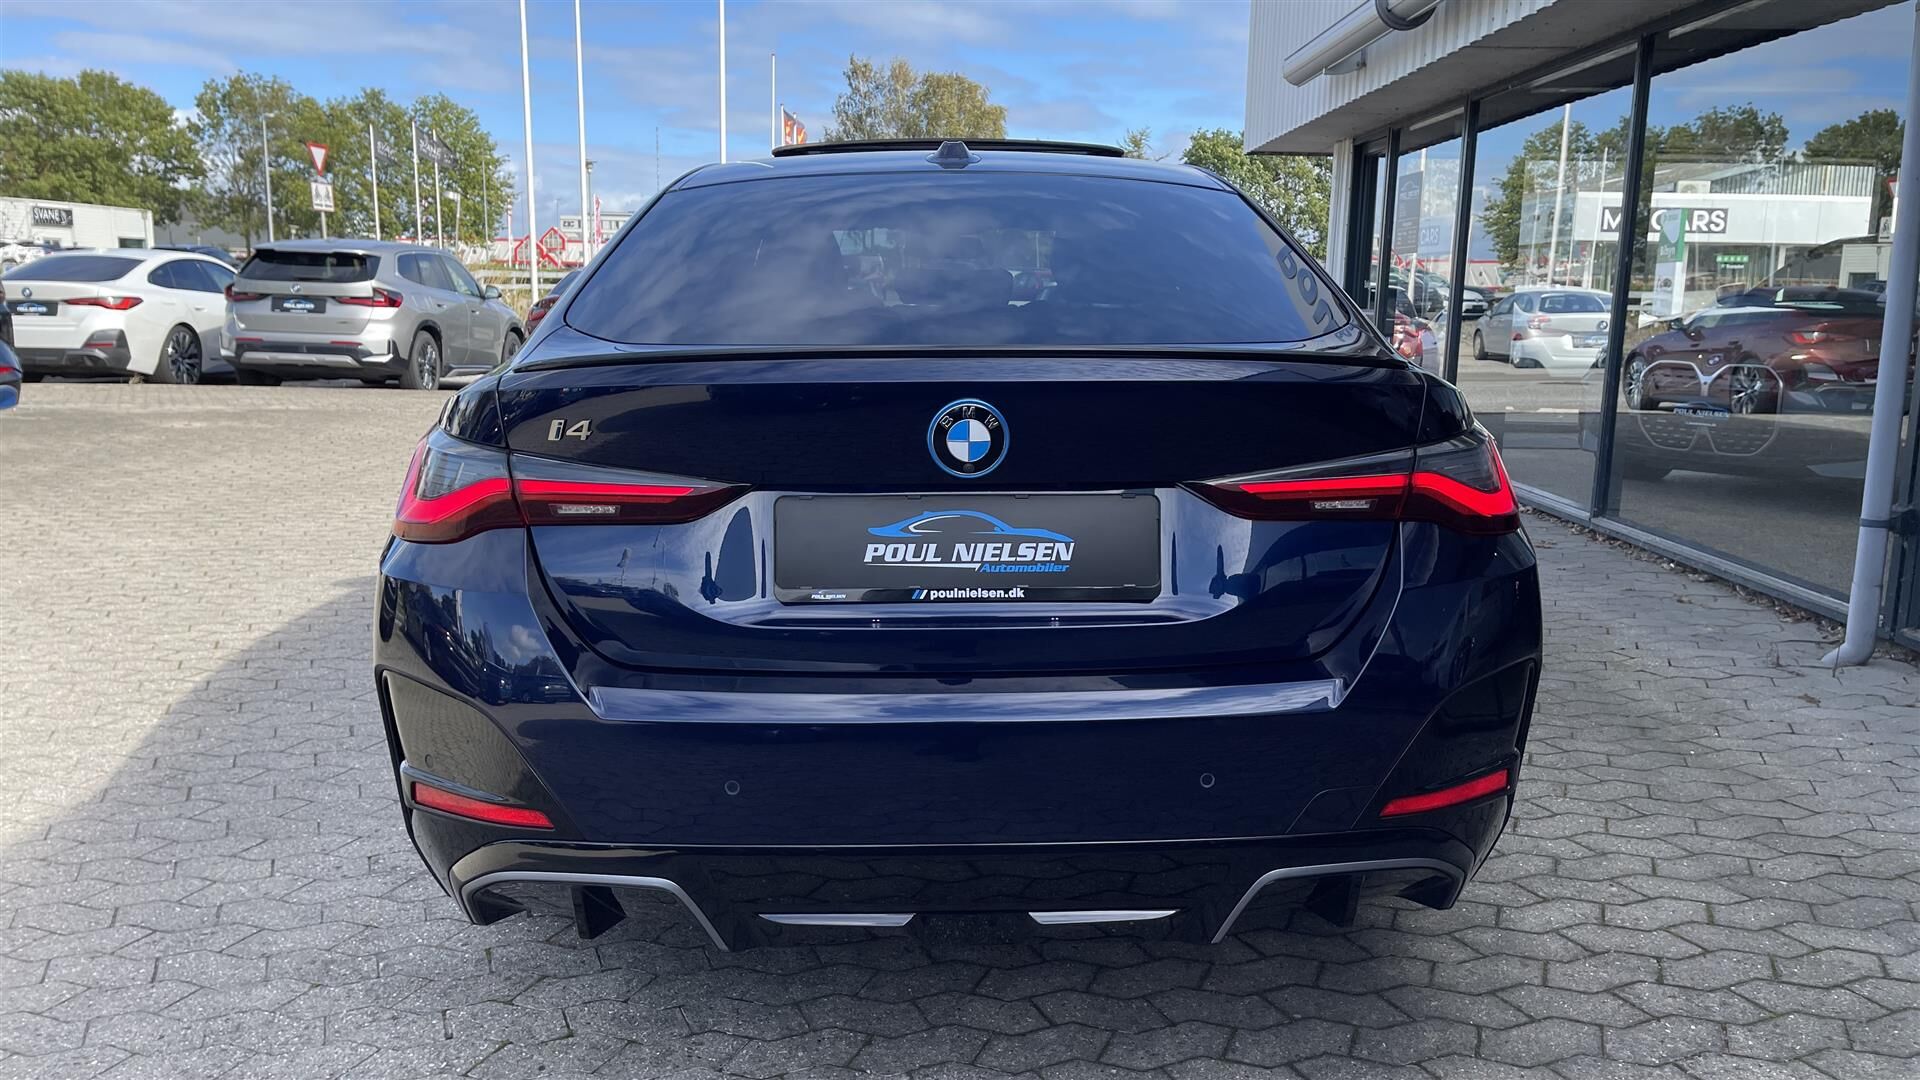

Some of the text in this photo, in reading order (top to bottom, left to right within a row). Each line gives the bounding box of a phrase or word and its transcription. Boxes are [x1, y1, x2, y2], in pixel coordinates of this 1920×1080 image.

[33, 207, 61, 221] SVANE
[940, 406, 999, 430] BMW
[547, 419, 593, 441] i4
[864, 542, 1075, 562] POUL NIELSEN
[979, 563, 1070, 573] Automobiler
[930, 587, 1025, 600] poulnielsen.dk
